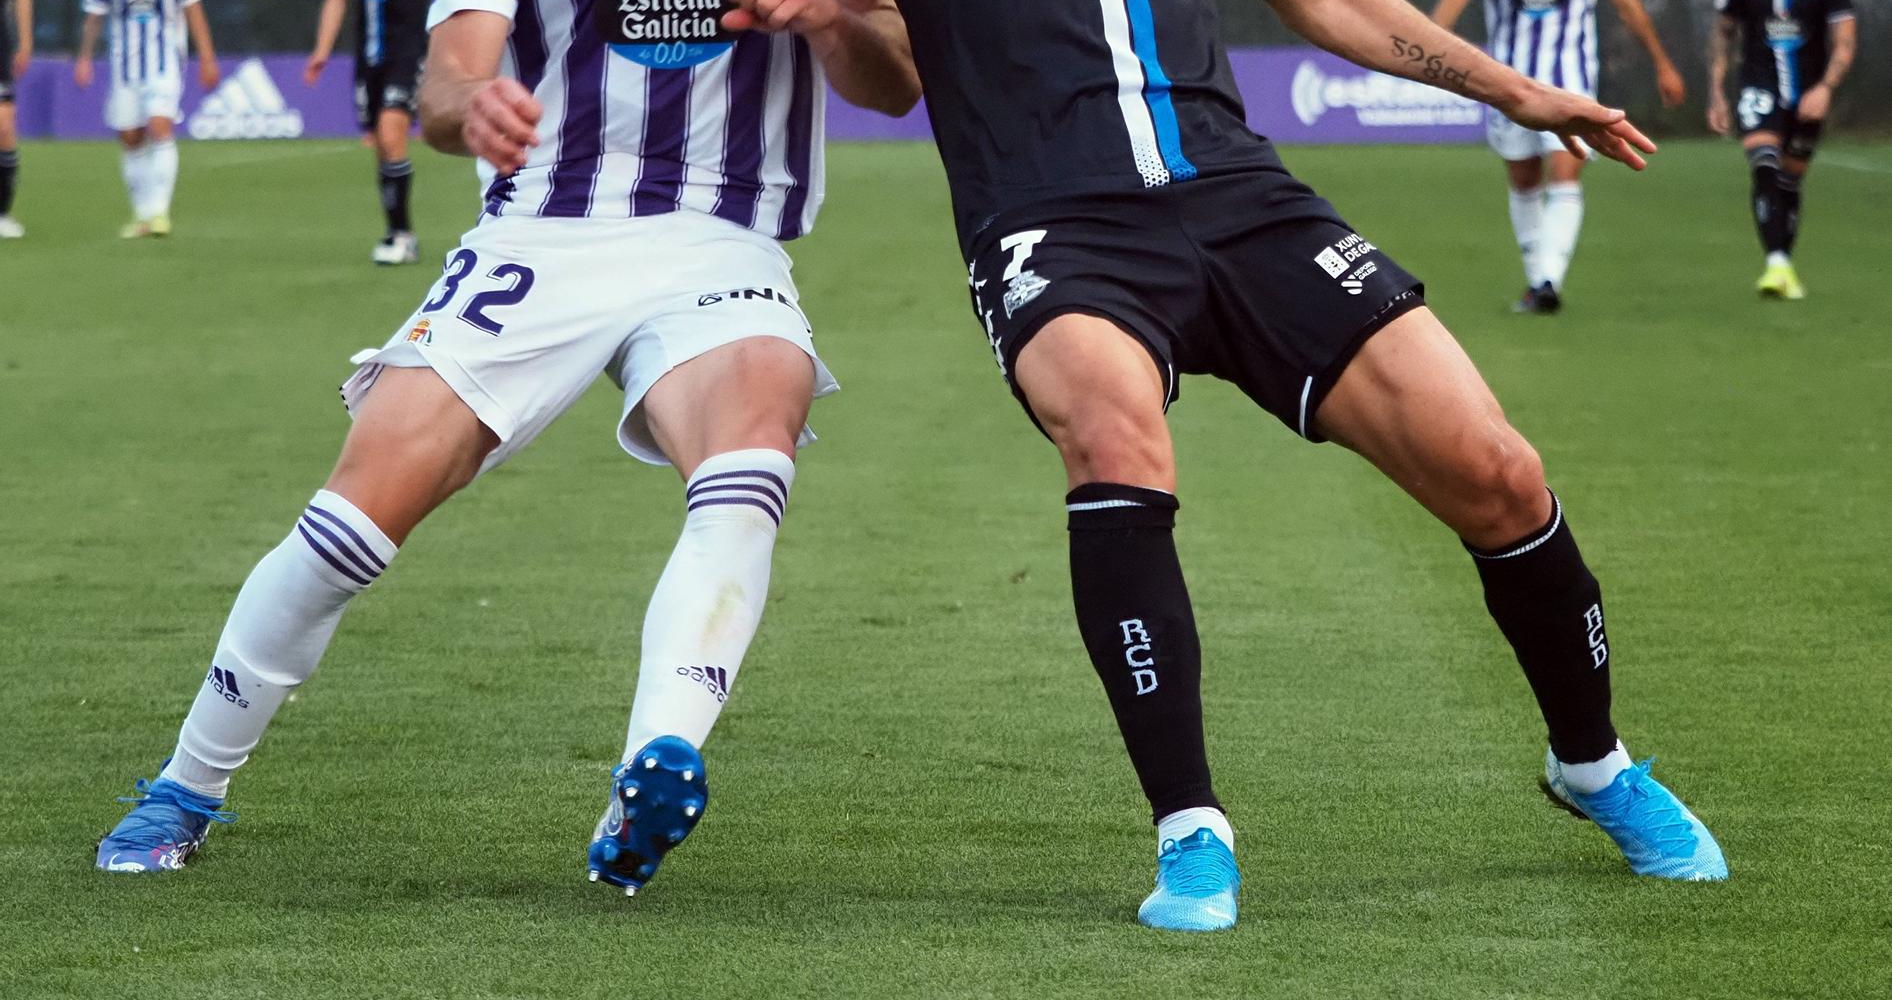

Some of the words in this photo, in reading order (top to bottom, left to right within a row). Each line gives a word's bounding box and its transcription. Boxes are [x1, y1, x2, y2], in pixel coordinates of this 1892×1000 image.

[621, 12, 718, 40] Galicia
[1000, 229, 1048, 282] 7
[419, 248, 536, 338] 32
[1119, 619, 1159, 695] RCD
[1583, 603, 1608, 669] RCD
